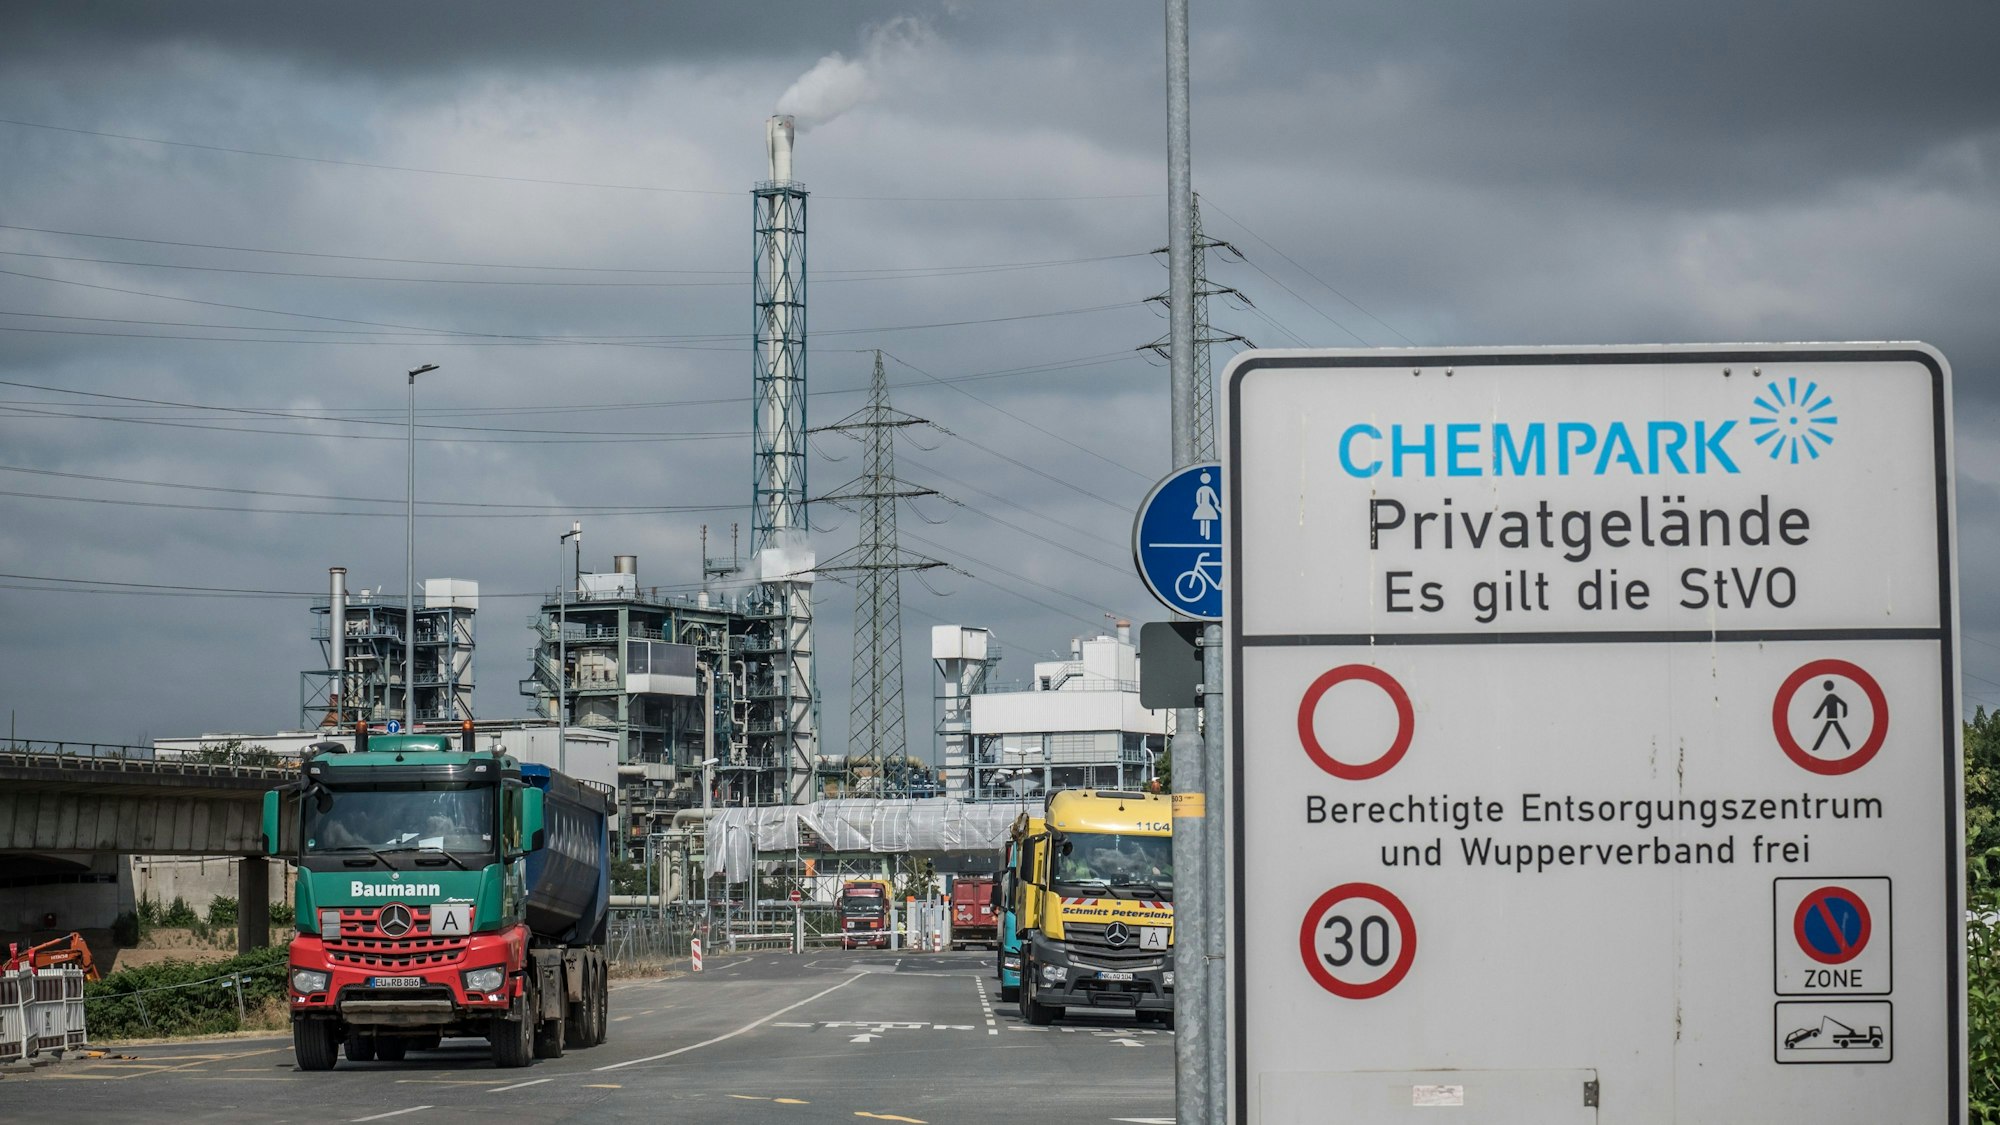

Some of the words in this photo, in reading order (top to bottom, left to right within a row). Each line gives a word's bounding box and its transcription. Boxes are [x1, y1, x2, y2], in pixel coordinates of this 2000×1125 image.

[1338, 420, 1741, 479] CHEMPARK
[1370, 495, 1810, 561] Privatgelände
[1386, 570, 1444, 613] Es
[1474, 569, 1549, 623] gilt
[1578, 568, 1650, 611] die
[1680, 566, 1796, 610] StVO
[1306, 795, 1504, 831] Berechtigte
[1522, 792, 1883, 830] Entsorgungszentrum
[1381, 837, 1441, 867] und
[1460, 835, 1734, 874] Wupperverband
[1752, 835, 1810, 865] frei
[351, 880, 441, 897] Baumann
[442, 910, 459, 931] A
[1062, 907, 1109, 916] Schmitt
[1111, 909, 1174, 919] Peterslahr
[1147, 932, 1160, 946] A
[1324, 915, 1390, 968] 30
[1804, 968, 1863, 989] ZONE
